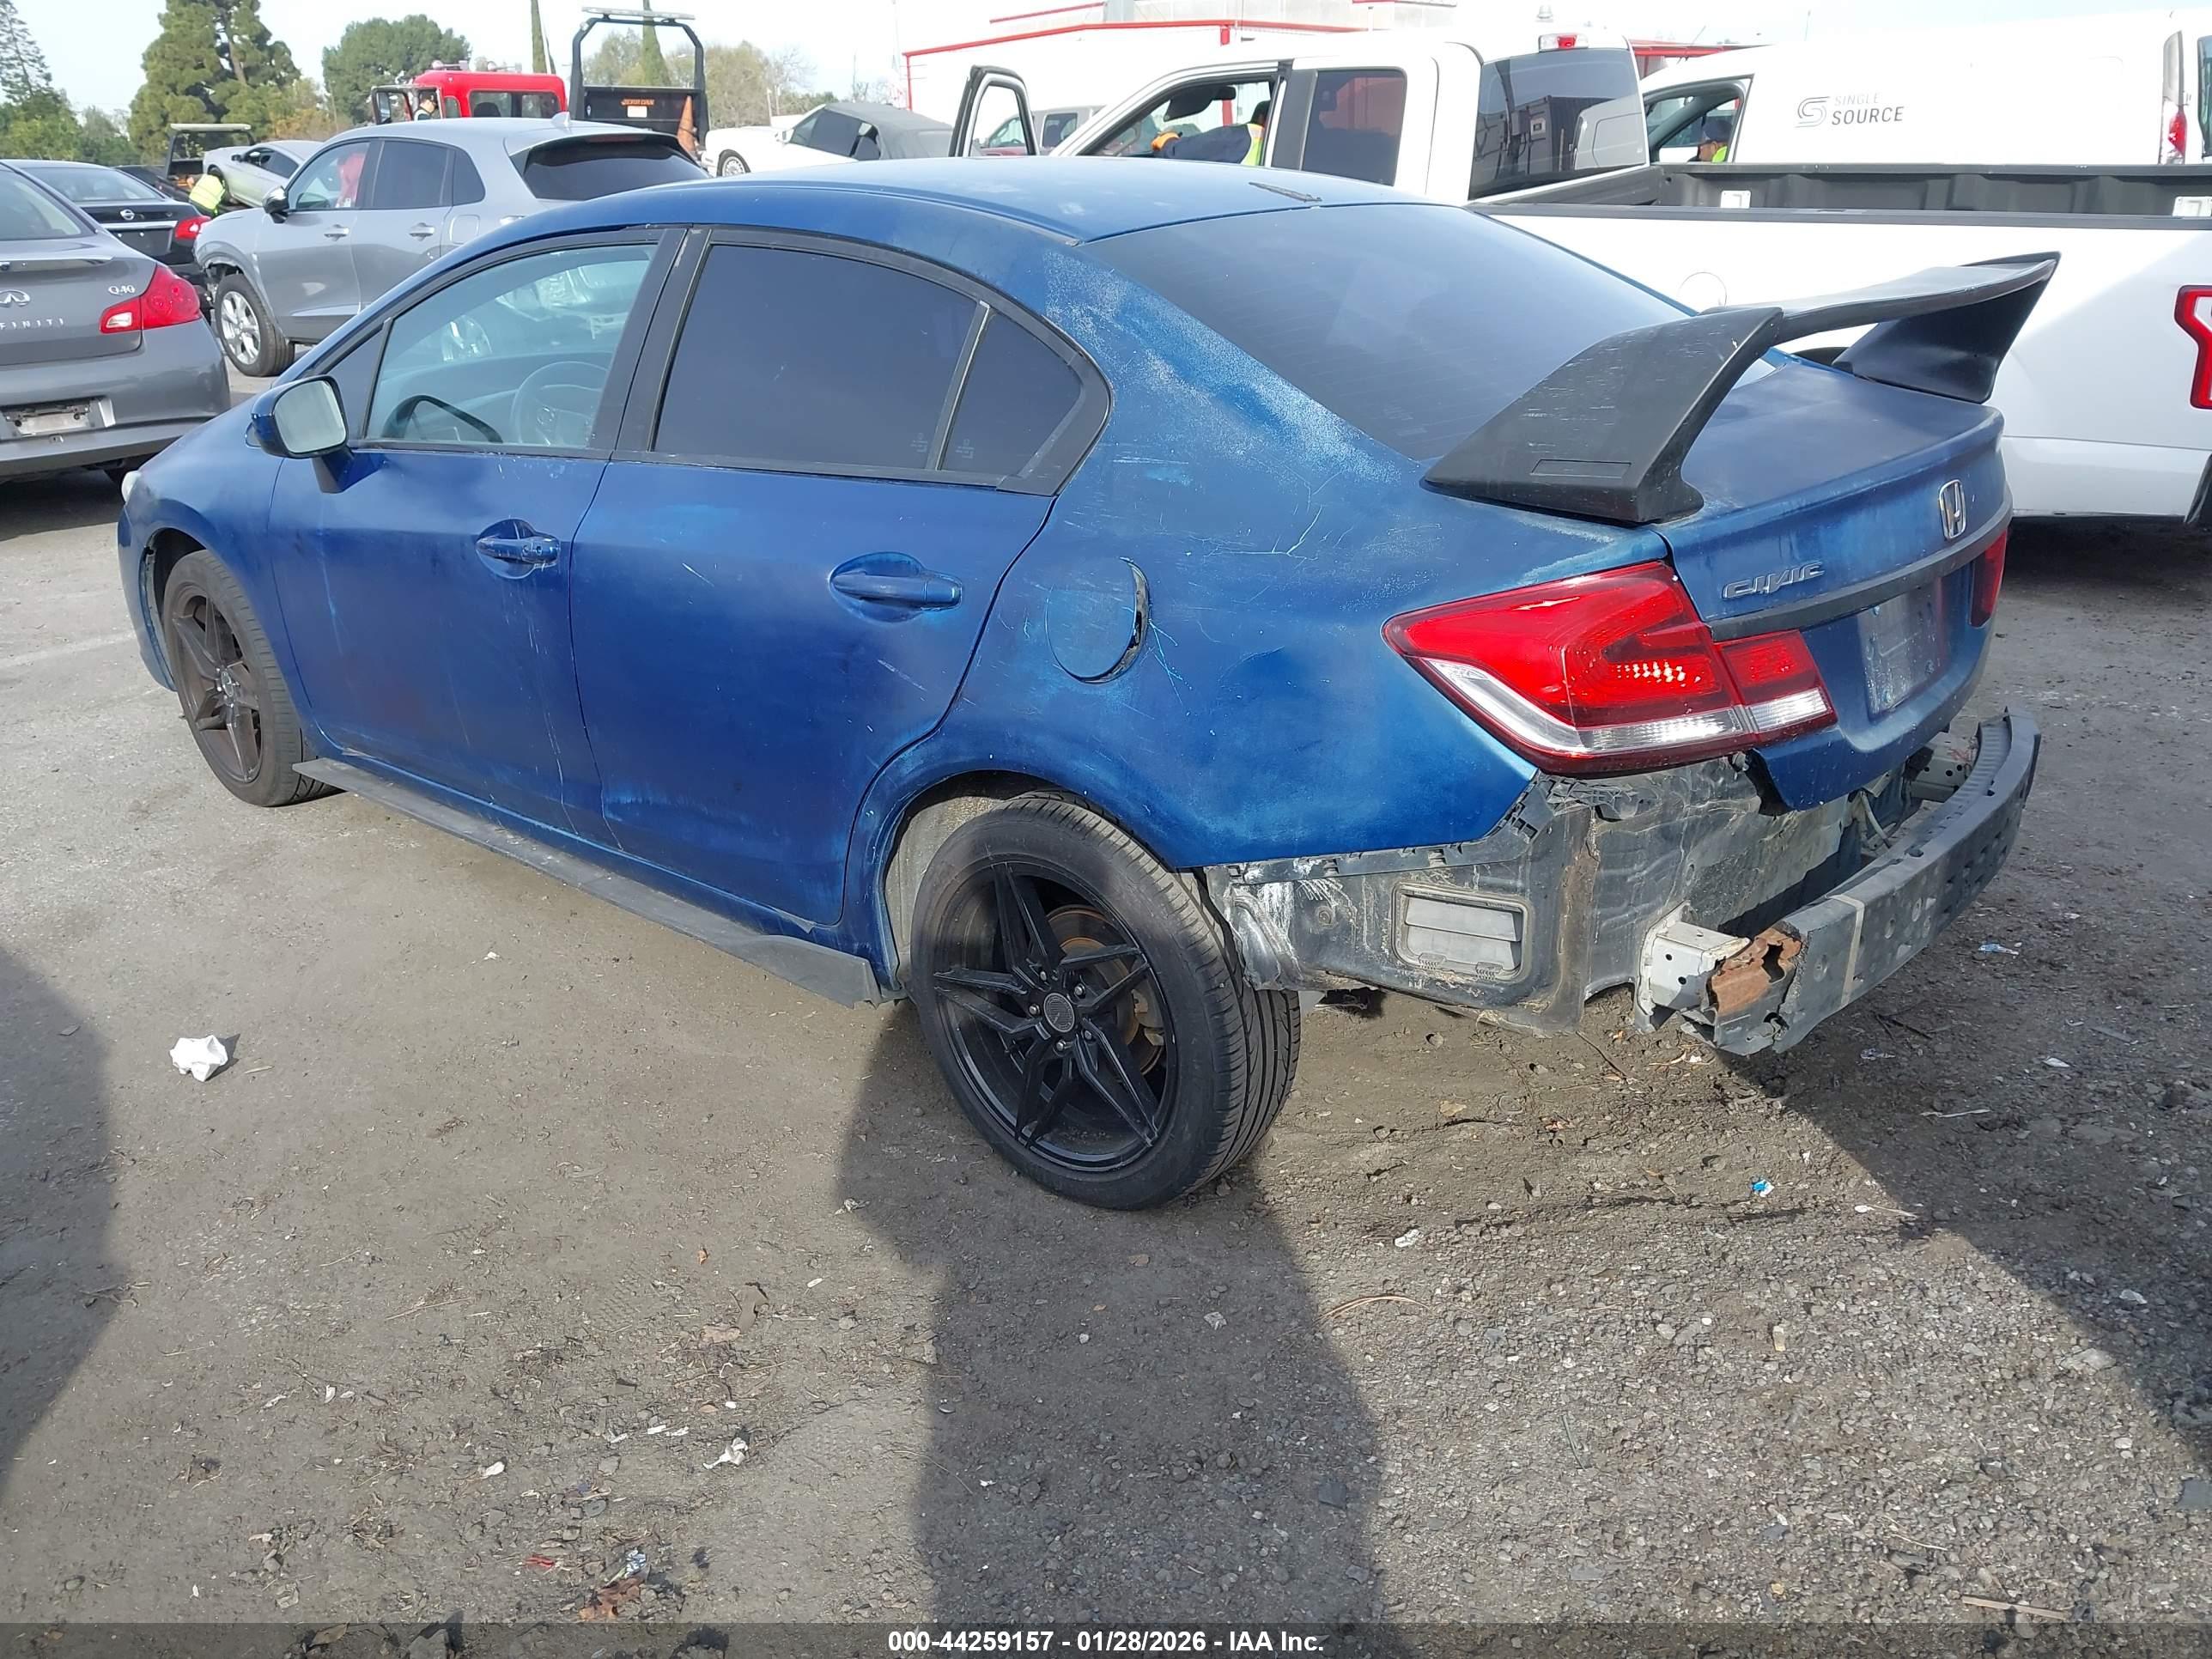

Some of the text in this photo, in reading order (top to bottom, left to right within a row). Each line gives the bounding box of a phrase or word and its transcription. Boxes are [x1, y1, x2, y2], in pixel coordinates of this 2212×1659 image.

[1831, 106, 1905, 125] SOURCE
[107, 284, 136, 295] Q40
[1723, 561, 1826, 599] CIVIC
